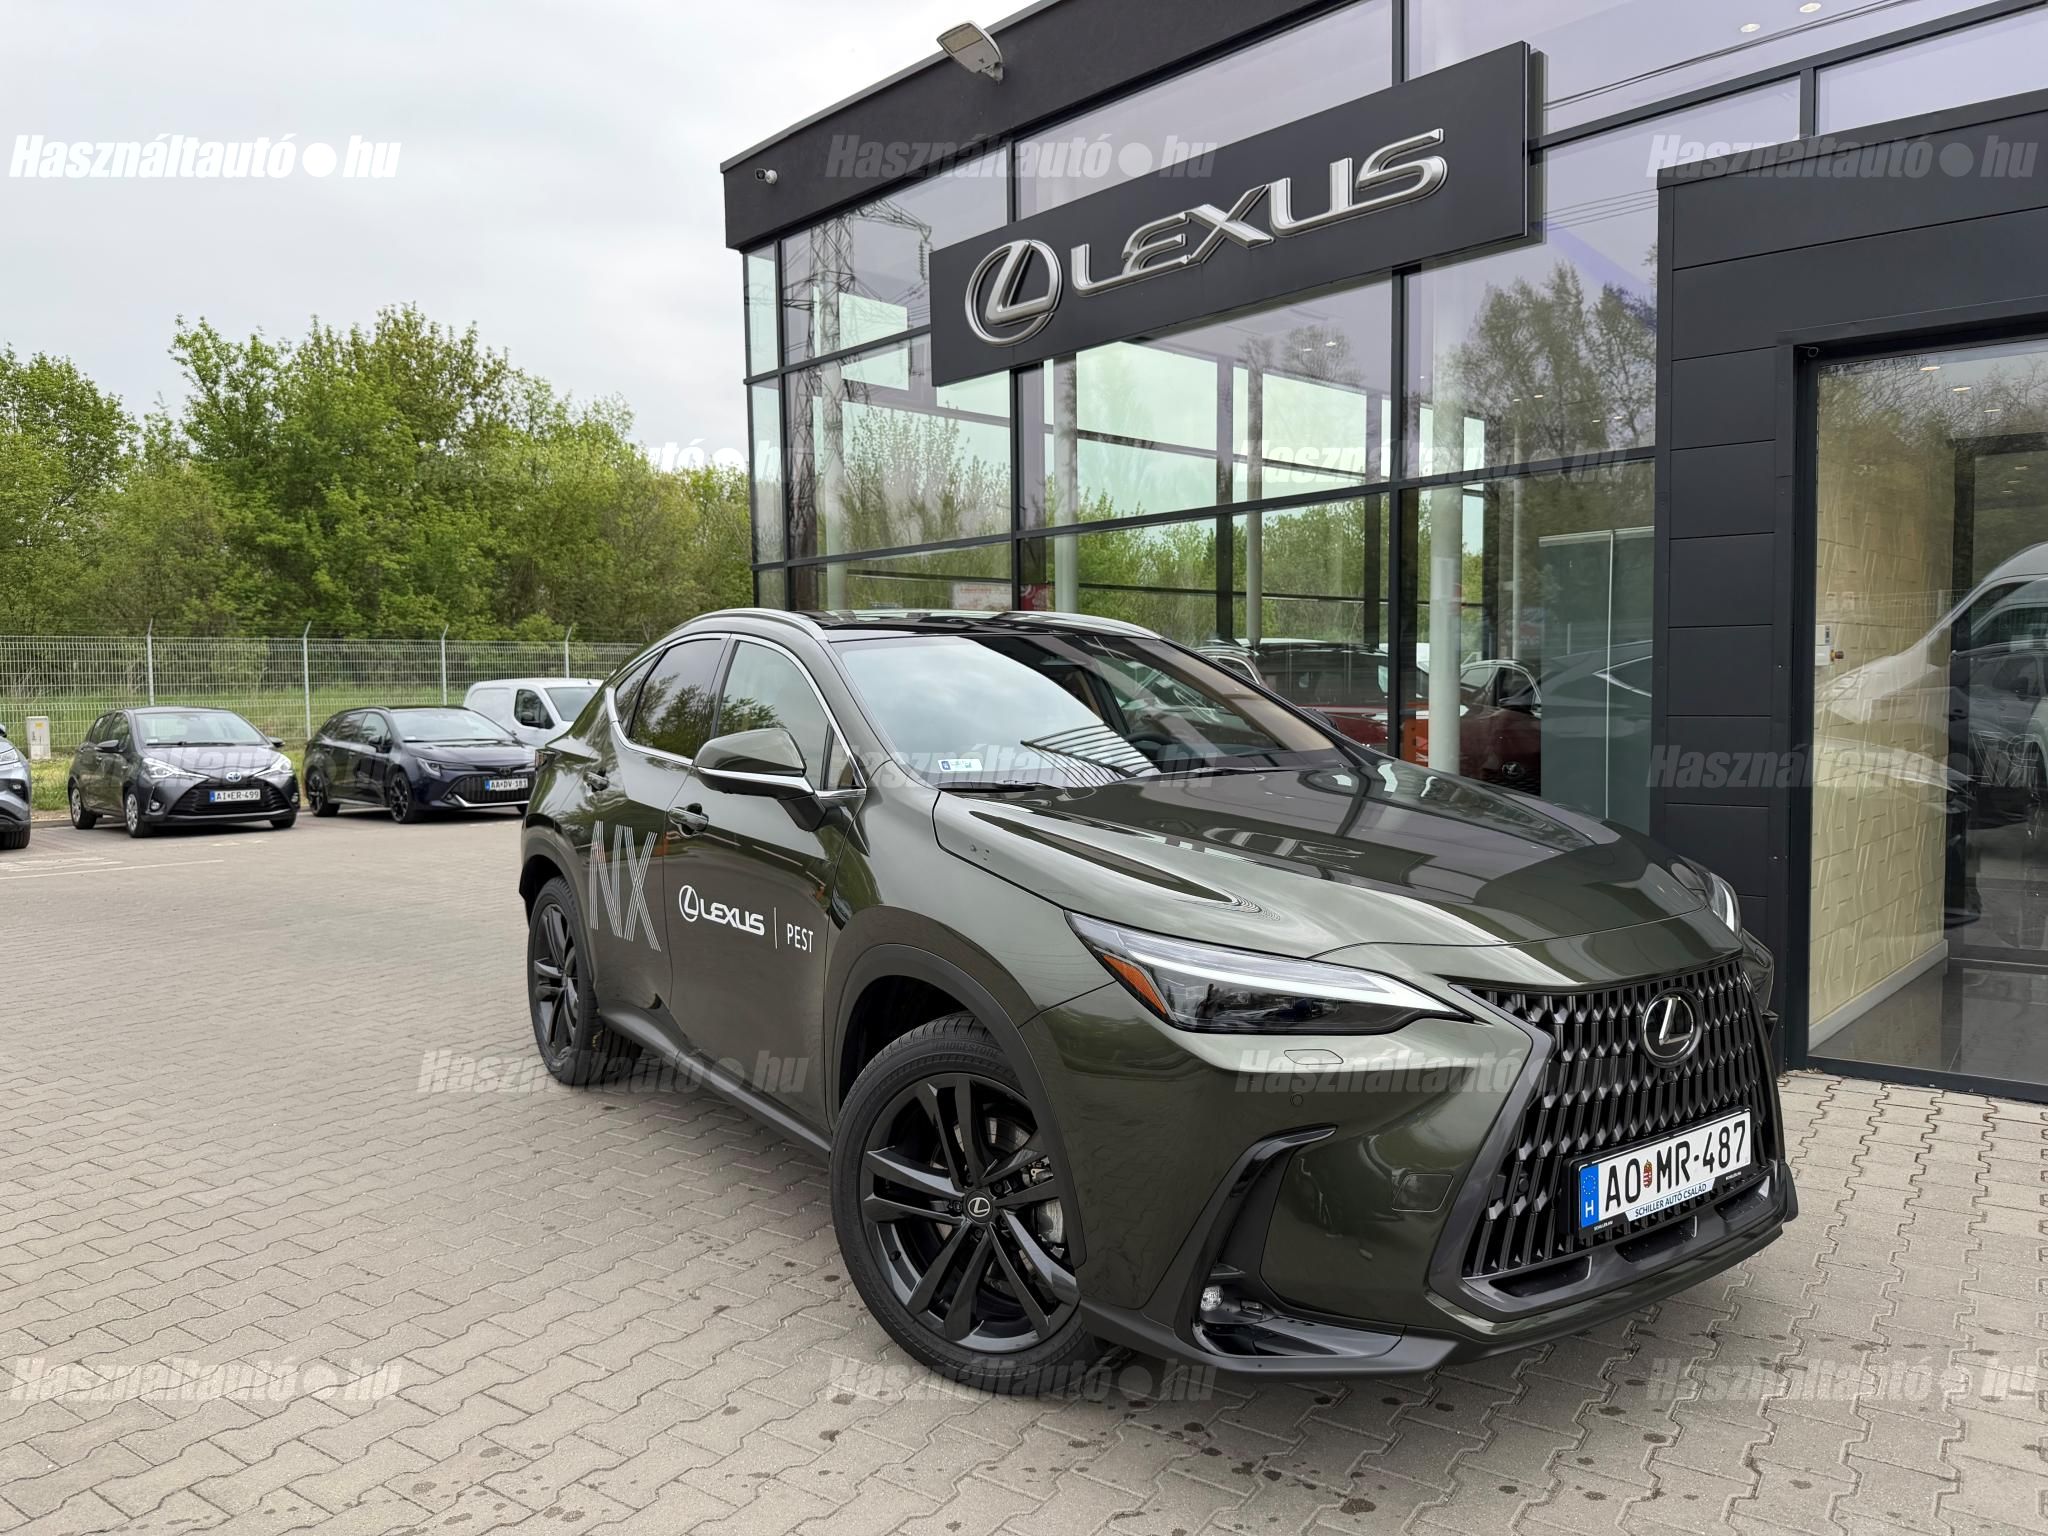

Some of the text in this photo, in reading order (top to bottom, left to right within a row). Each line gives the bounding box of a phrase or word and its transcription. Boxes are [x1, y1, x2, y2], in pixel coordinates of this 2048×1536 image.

[1071, 127, 1447, 297] LEXUS
[589, 820, 661, 952] NX
[700, 898, 765, 936] LEXUS
[787, 923, 813, 953] PEST
[1585, 1200, 1594, 1218] H
[1635, 1200, 1664, 1218] SCHILLER
